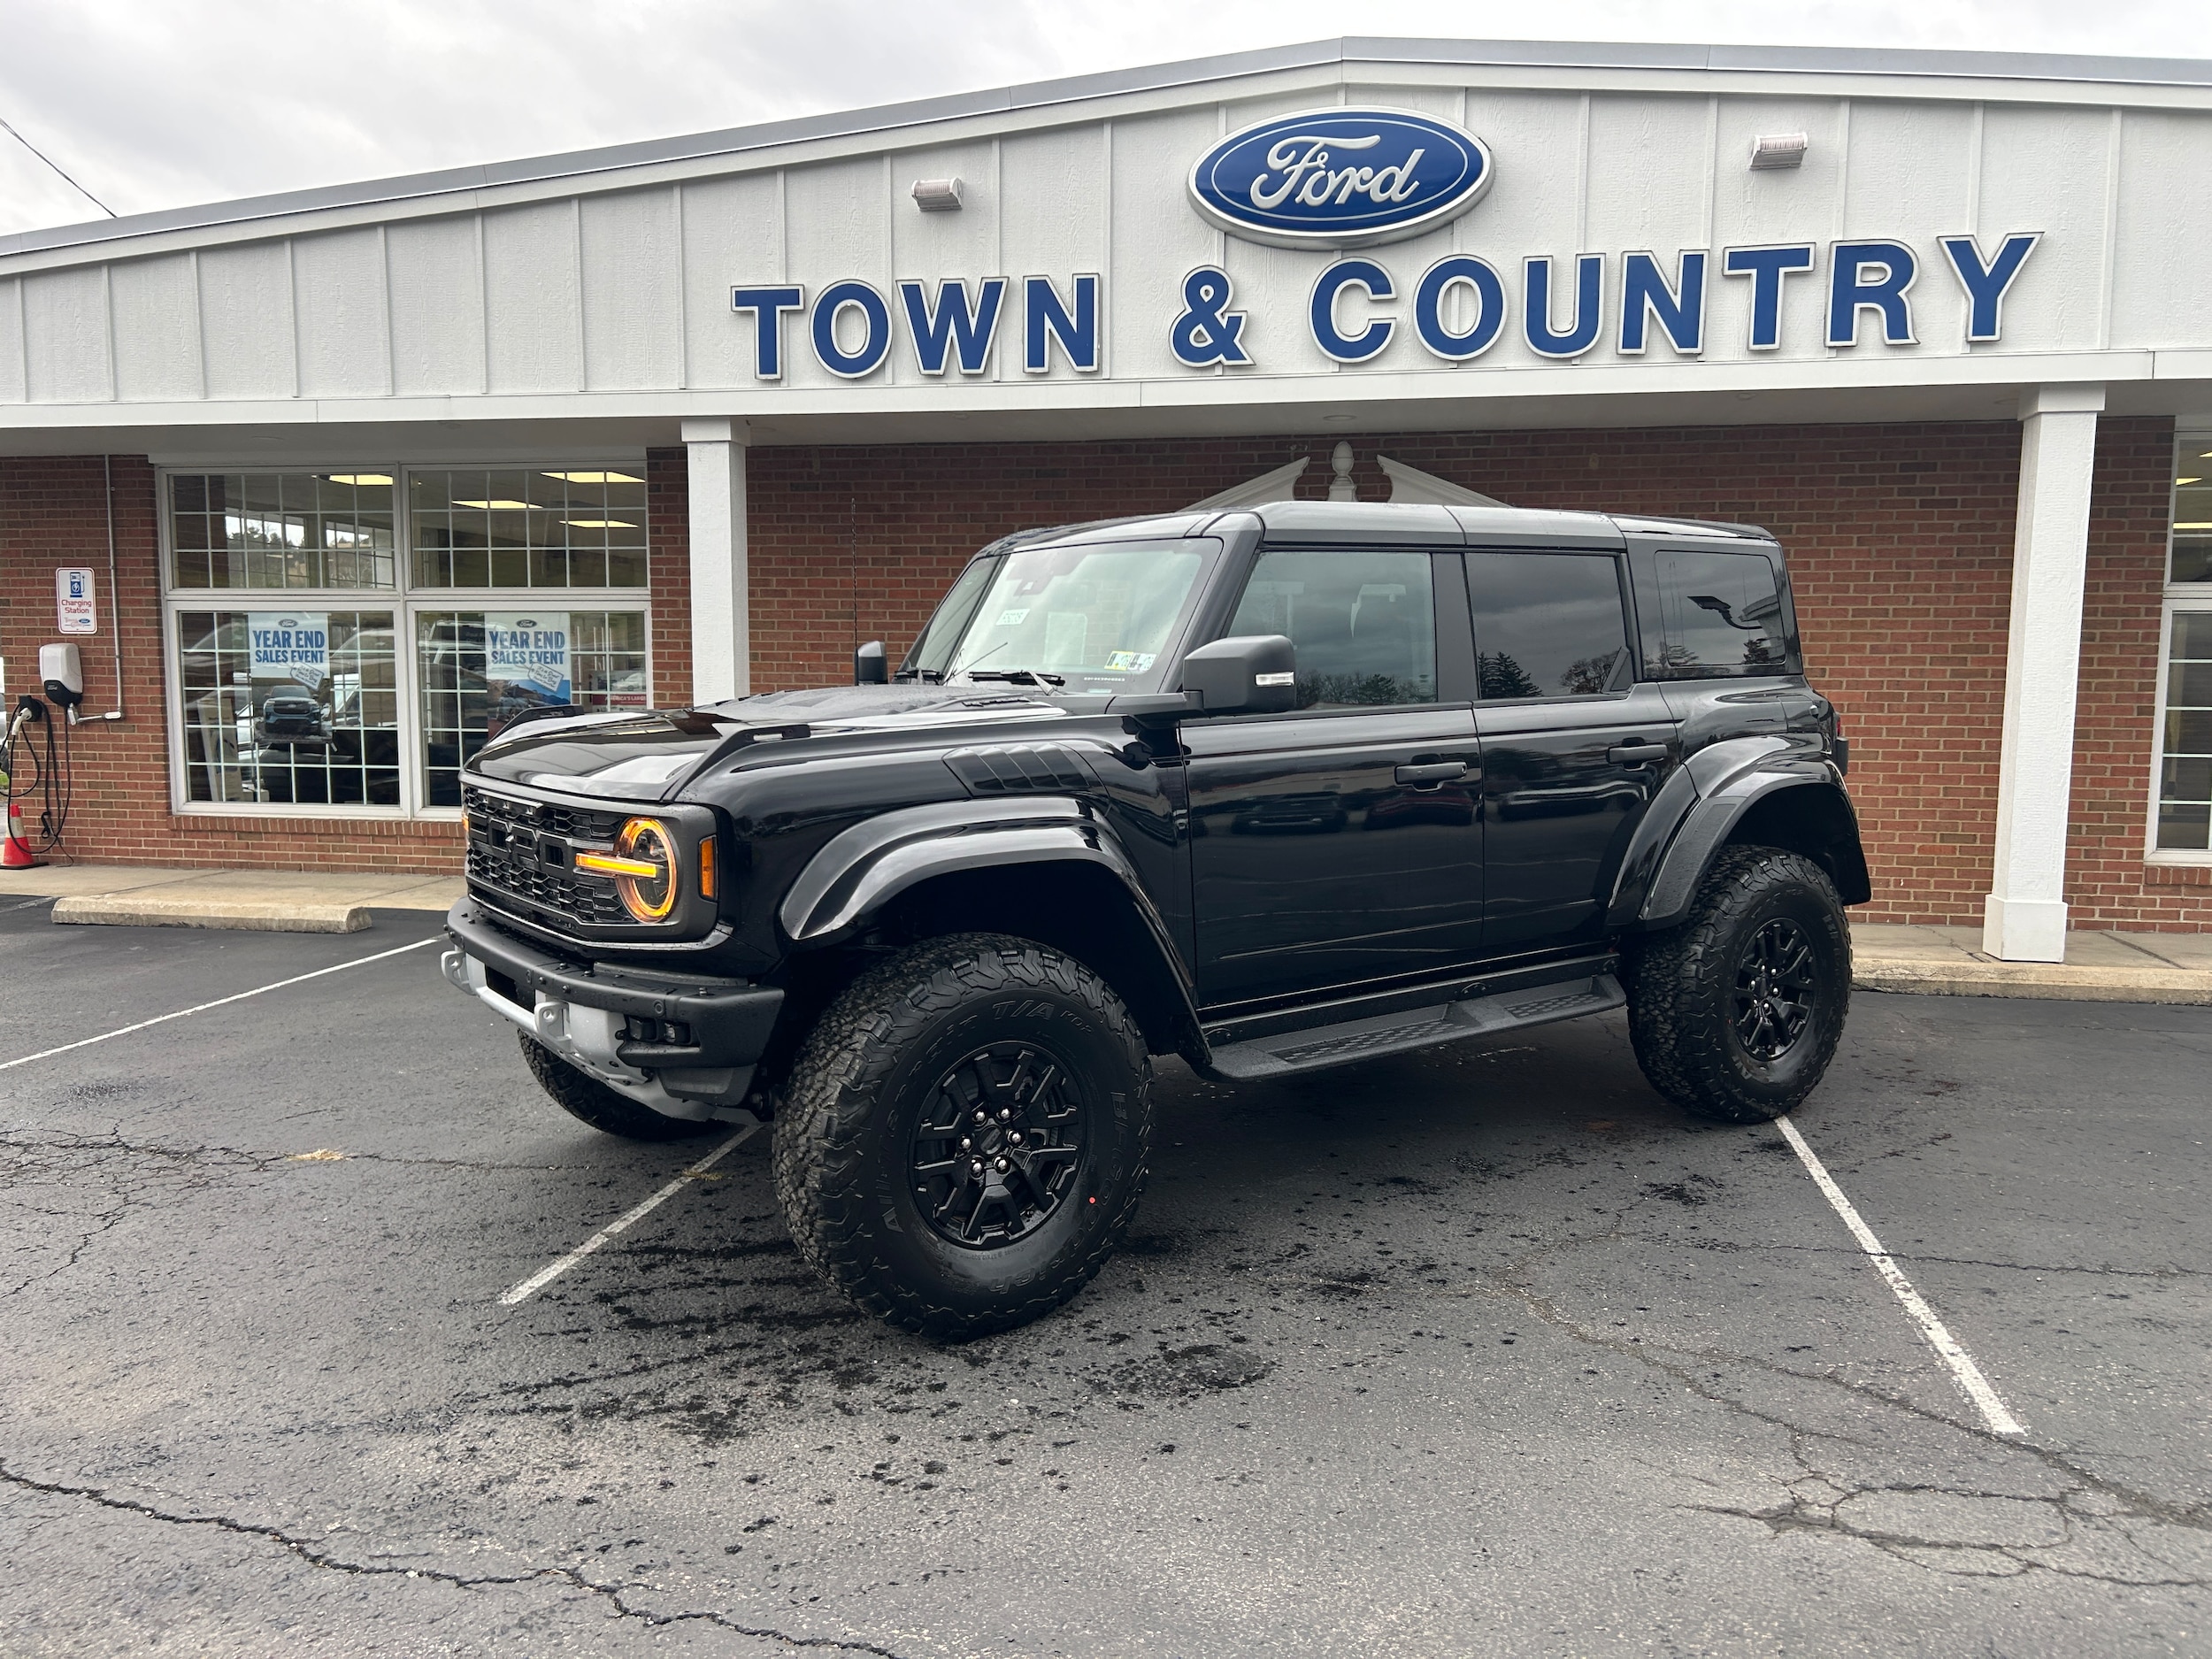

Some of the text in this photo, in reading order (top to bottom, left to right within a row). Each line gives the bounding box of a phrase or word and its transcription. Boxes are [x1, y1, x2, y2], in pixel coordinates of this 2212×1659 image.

[1249, 134, 1425, 209] Ford
[731, 231, 2045, 380] TOWN & COUNTRY
[252, 630, 326, 649] YEAR END
[488, 631, 530, 649] YEAR
[534, 631, 565, 649] END
[255, 649, 325, 664] SALES EVENT
[491, 650, 565, 664] SALES EVENT
[992, 1000, 1056, 1021] T/A
